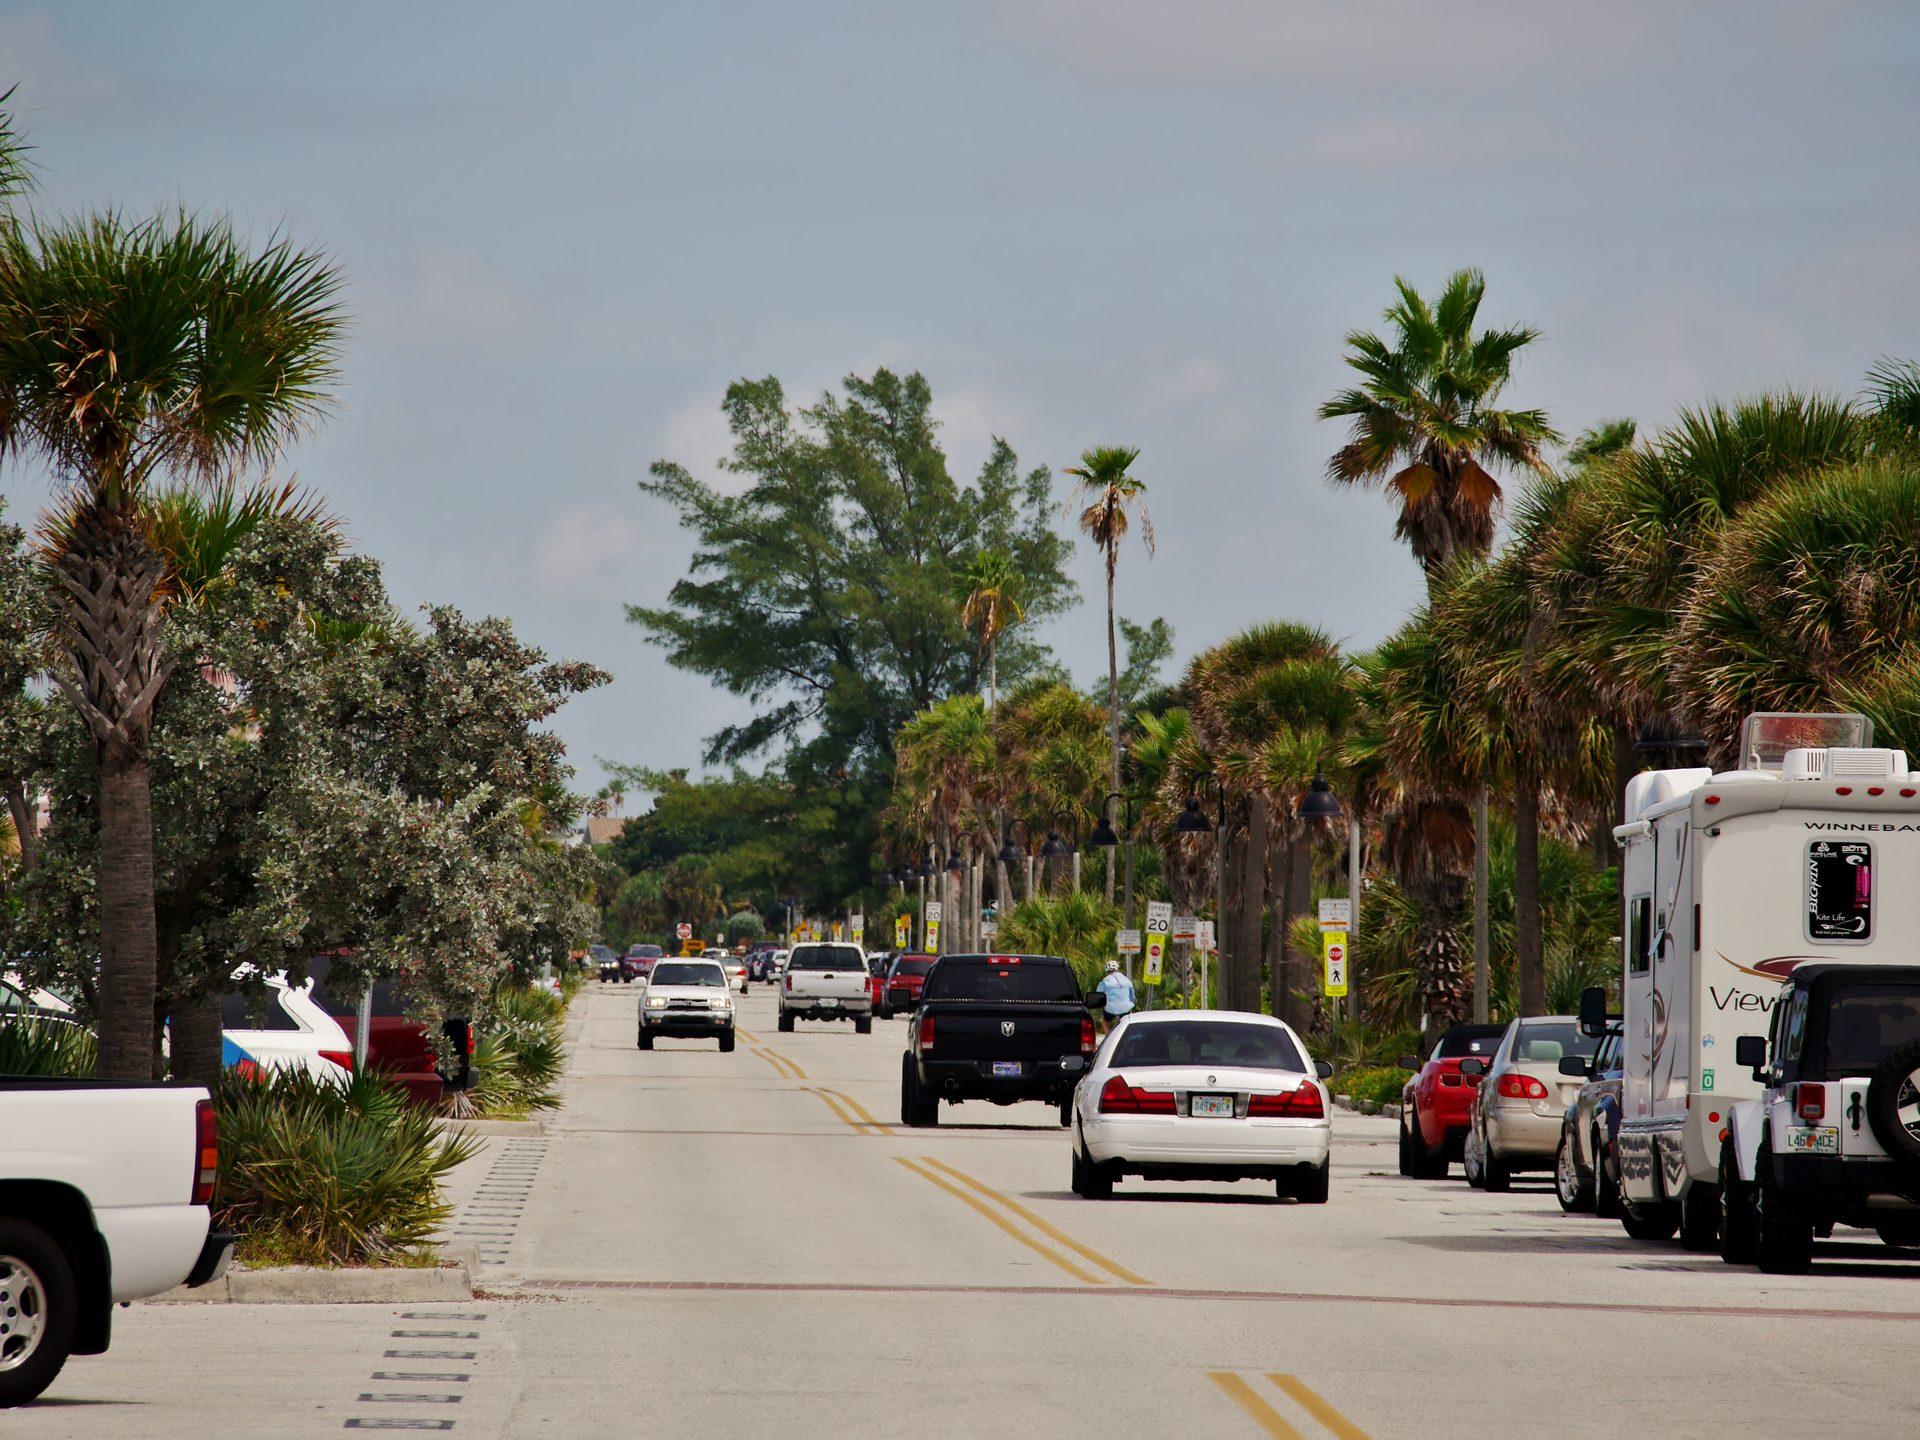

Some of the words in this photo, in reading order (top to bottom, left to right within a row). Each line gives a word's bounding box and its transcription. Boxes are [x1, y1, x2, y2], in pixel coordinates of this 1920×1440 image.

[1805, 822, 1920, 832] WINNEBA
[927, 911, 940, 919] 20
[1832, 912, 1846, 921] Life
[1148, 918, 1168, 931] 20
[1328, 950, 1343, 958] STOP
